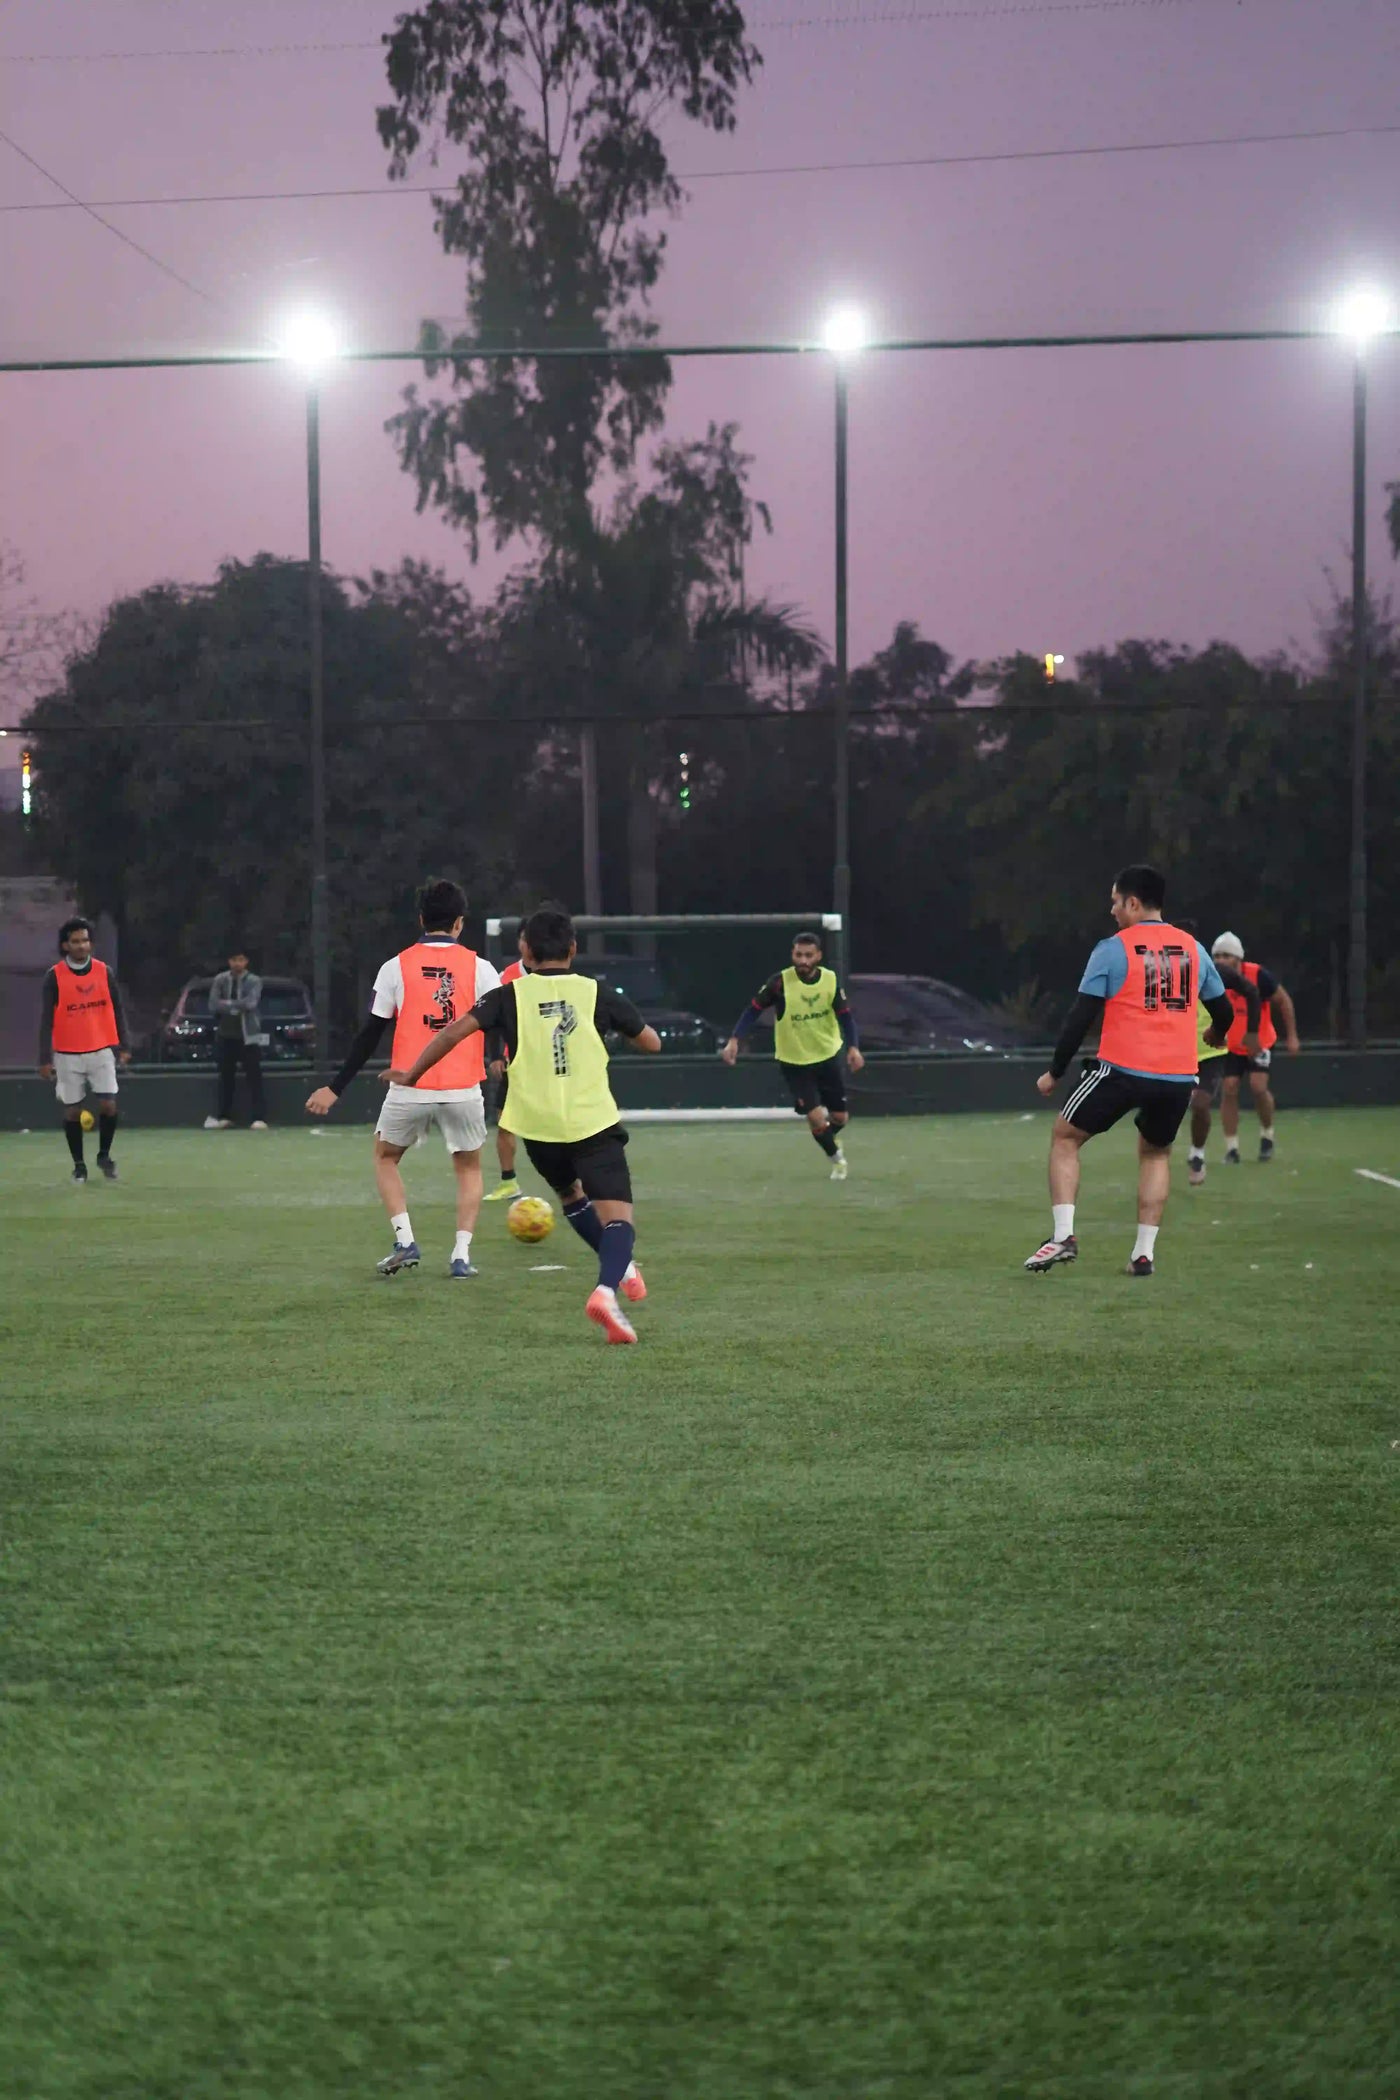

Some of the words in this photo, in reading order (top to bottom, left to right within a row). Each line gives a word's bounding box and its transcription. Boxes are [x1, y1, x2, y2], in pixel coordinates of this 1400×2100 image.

[421, 966, 455, 1032] 3
[1134, 945, 1192, 1012] 10
[538, 1000, 577, 1077] 7
